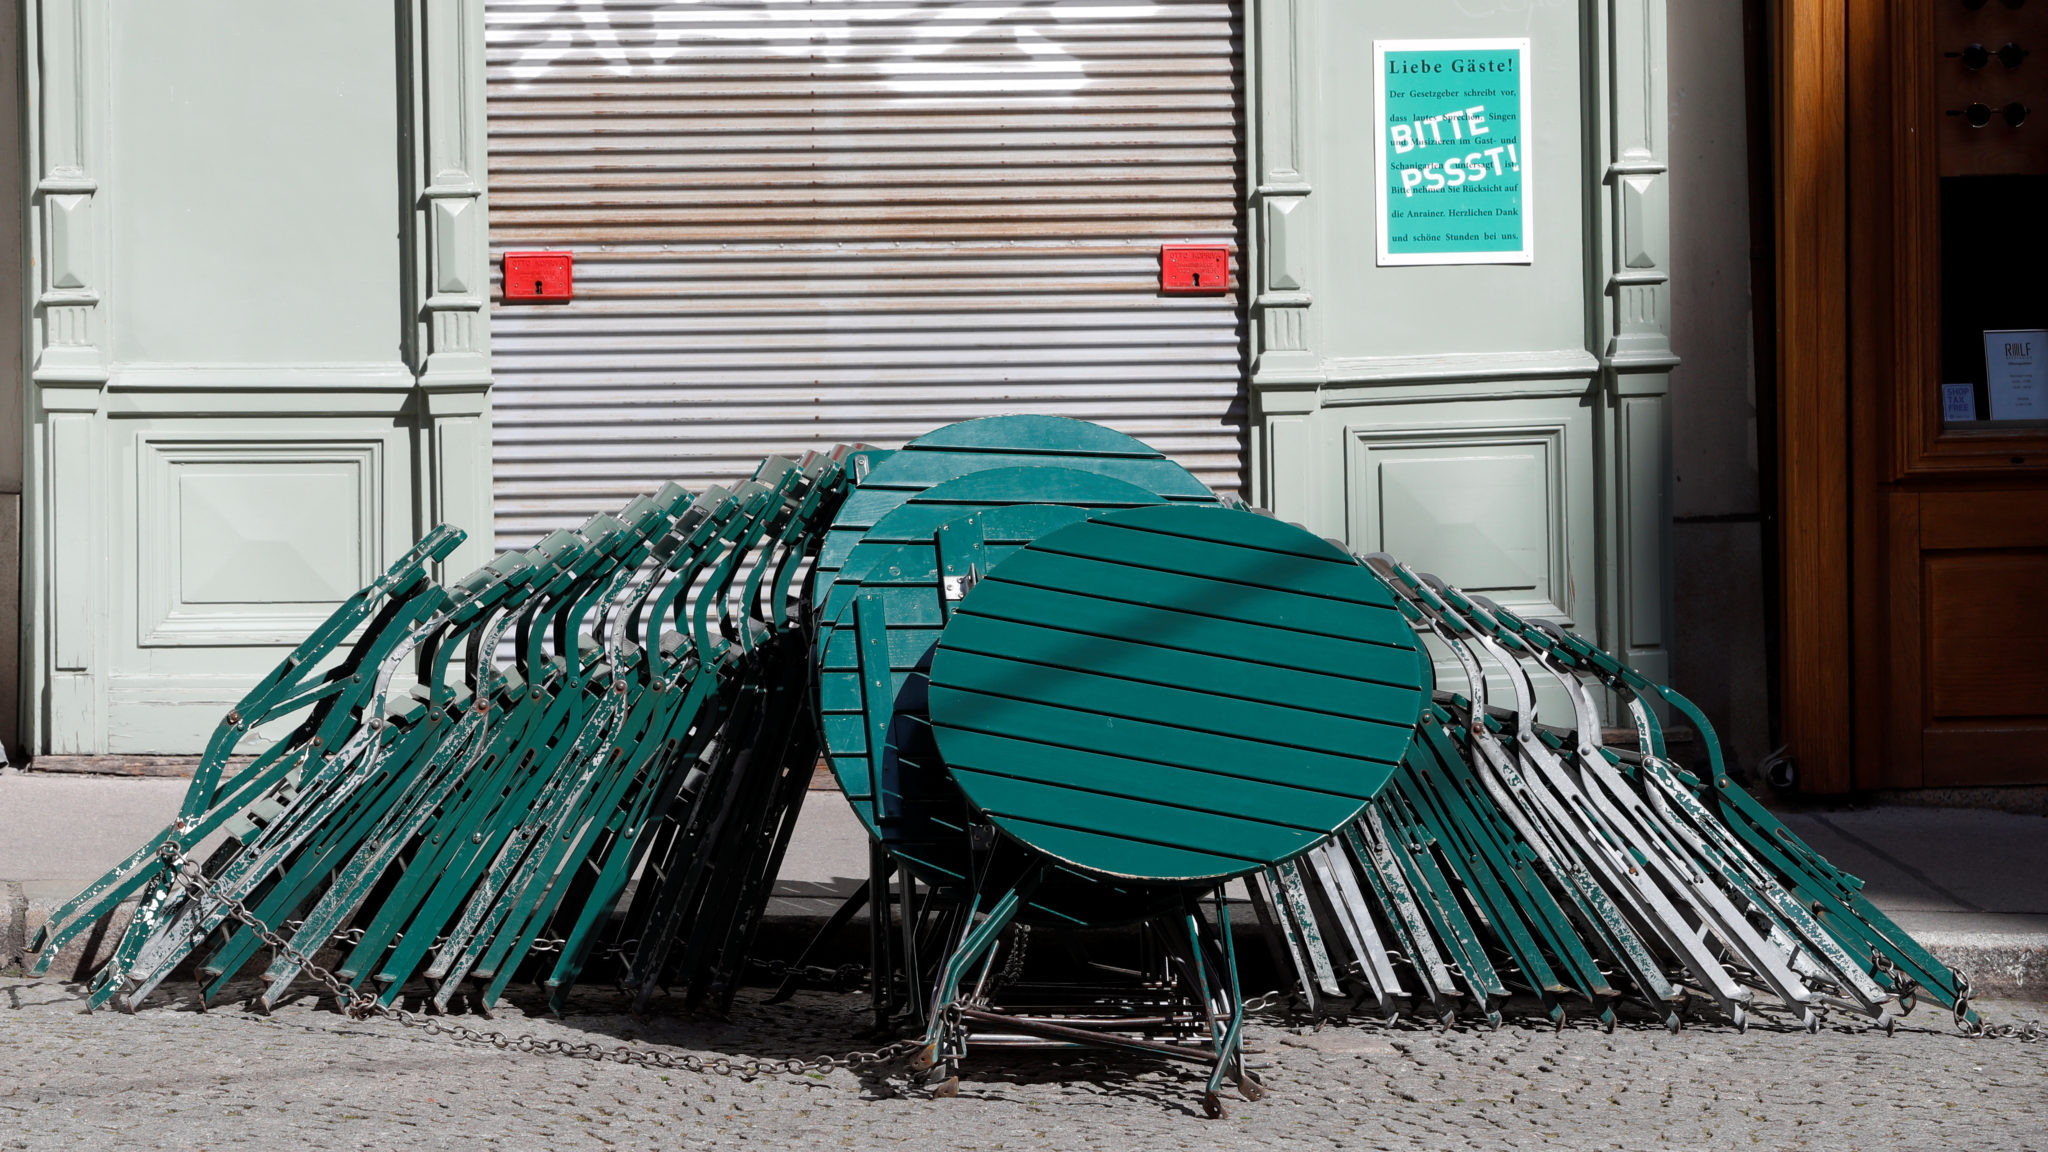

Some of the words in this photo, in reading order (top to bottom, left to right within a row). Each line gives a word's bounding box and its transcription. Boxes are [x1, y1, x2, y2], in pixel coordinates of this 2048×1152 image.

[1389, 60, 1442, 74] Liebe
[1451, 58, 1513, 73] Gäste!
[1389, 90, 1405, 98] Der
[1409, 89, 1459, 100] Gesetzgeber
[1464, 88, 1496, 97] schreibt
[1501, 90, 1517, 98] vor,
[1389, 114, 1407, 122] dass
[1489, 112, 1517, 122] Singen
[1390, 105, 1490, 154] BITTE
[1411, 137, 1456, 146] Musizieren
[1474, 136, 1496, 145] Gast-
[1500, 135, 1517, 144] und
[1390, 161, 1444, 171] Schanigarten
[1400, 144, 1520, 197] PSSST!
[1391, 186, 1411, 194] Bitte
[1412, 185, 1446, 194] nehmen
[1447, 185, 1461, 193] Sie
[1462, 184, 1503, 193] Rücksicht
[1504, 183, 1519, 192] auf
[1391, 209, 1404, 218] die
[1407, 209, 1445, 218] Anrainer.
[1448, 208, 1493, 217] Herzlichen
[1495, 207, 1518, 216] Dank
[1392, 233, 1408, 242] und
[1413, 233, 1441, 242] schöne
[1445, 232, 1480, 241] Stunden
[1484, 231, 1497, 241] bei
[1501, 233, 1519, 241] uns.
[1948, 396, 1965, 404] TAX
[1948, 404, 1969, 412] FREE
